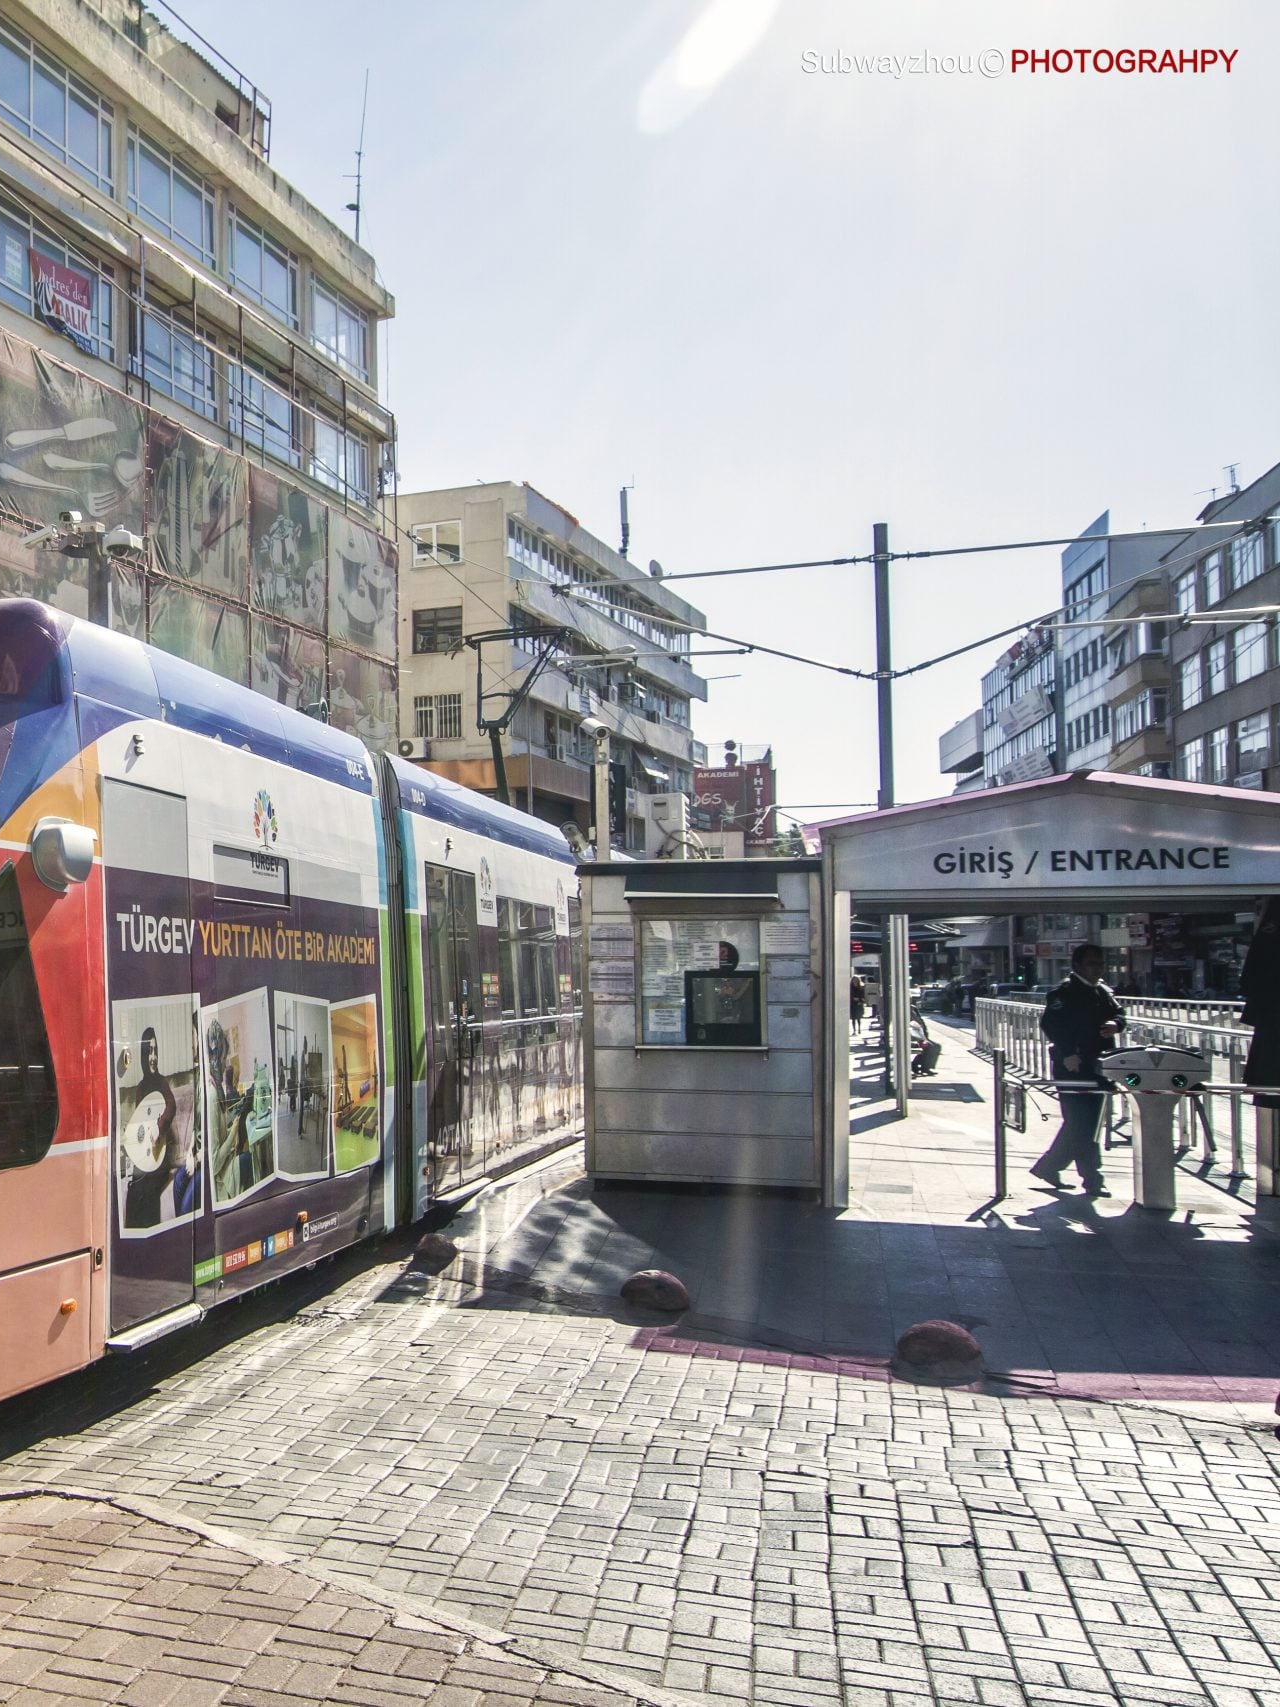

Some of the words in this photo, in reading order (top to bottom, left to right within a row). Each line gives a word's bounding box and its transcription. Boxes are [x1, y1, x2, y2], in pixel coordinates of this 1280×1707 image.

[933, 846, 1014, 879] GİRİŞ
[1050, 847, 1230, 873] ENTRANCE
[116, 904, 196, 955] TÜRGEV
[198, 919, 273, 959] YURTTAN
[275, 920, 302, 961] ÖTE
